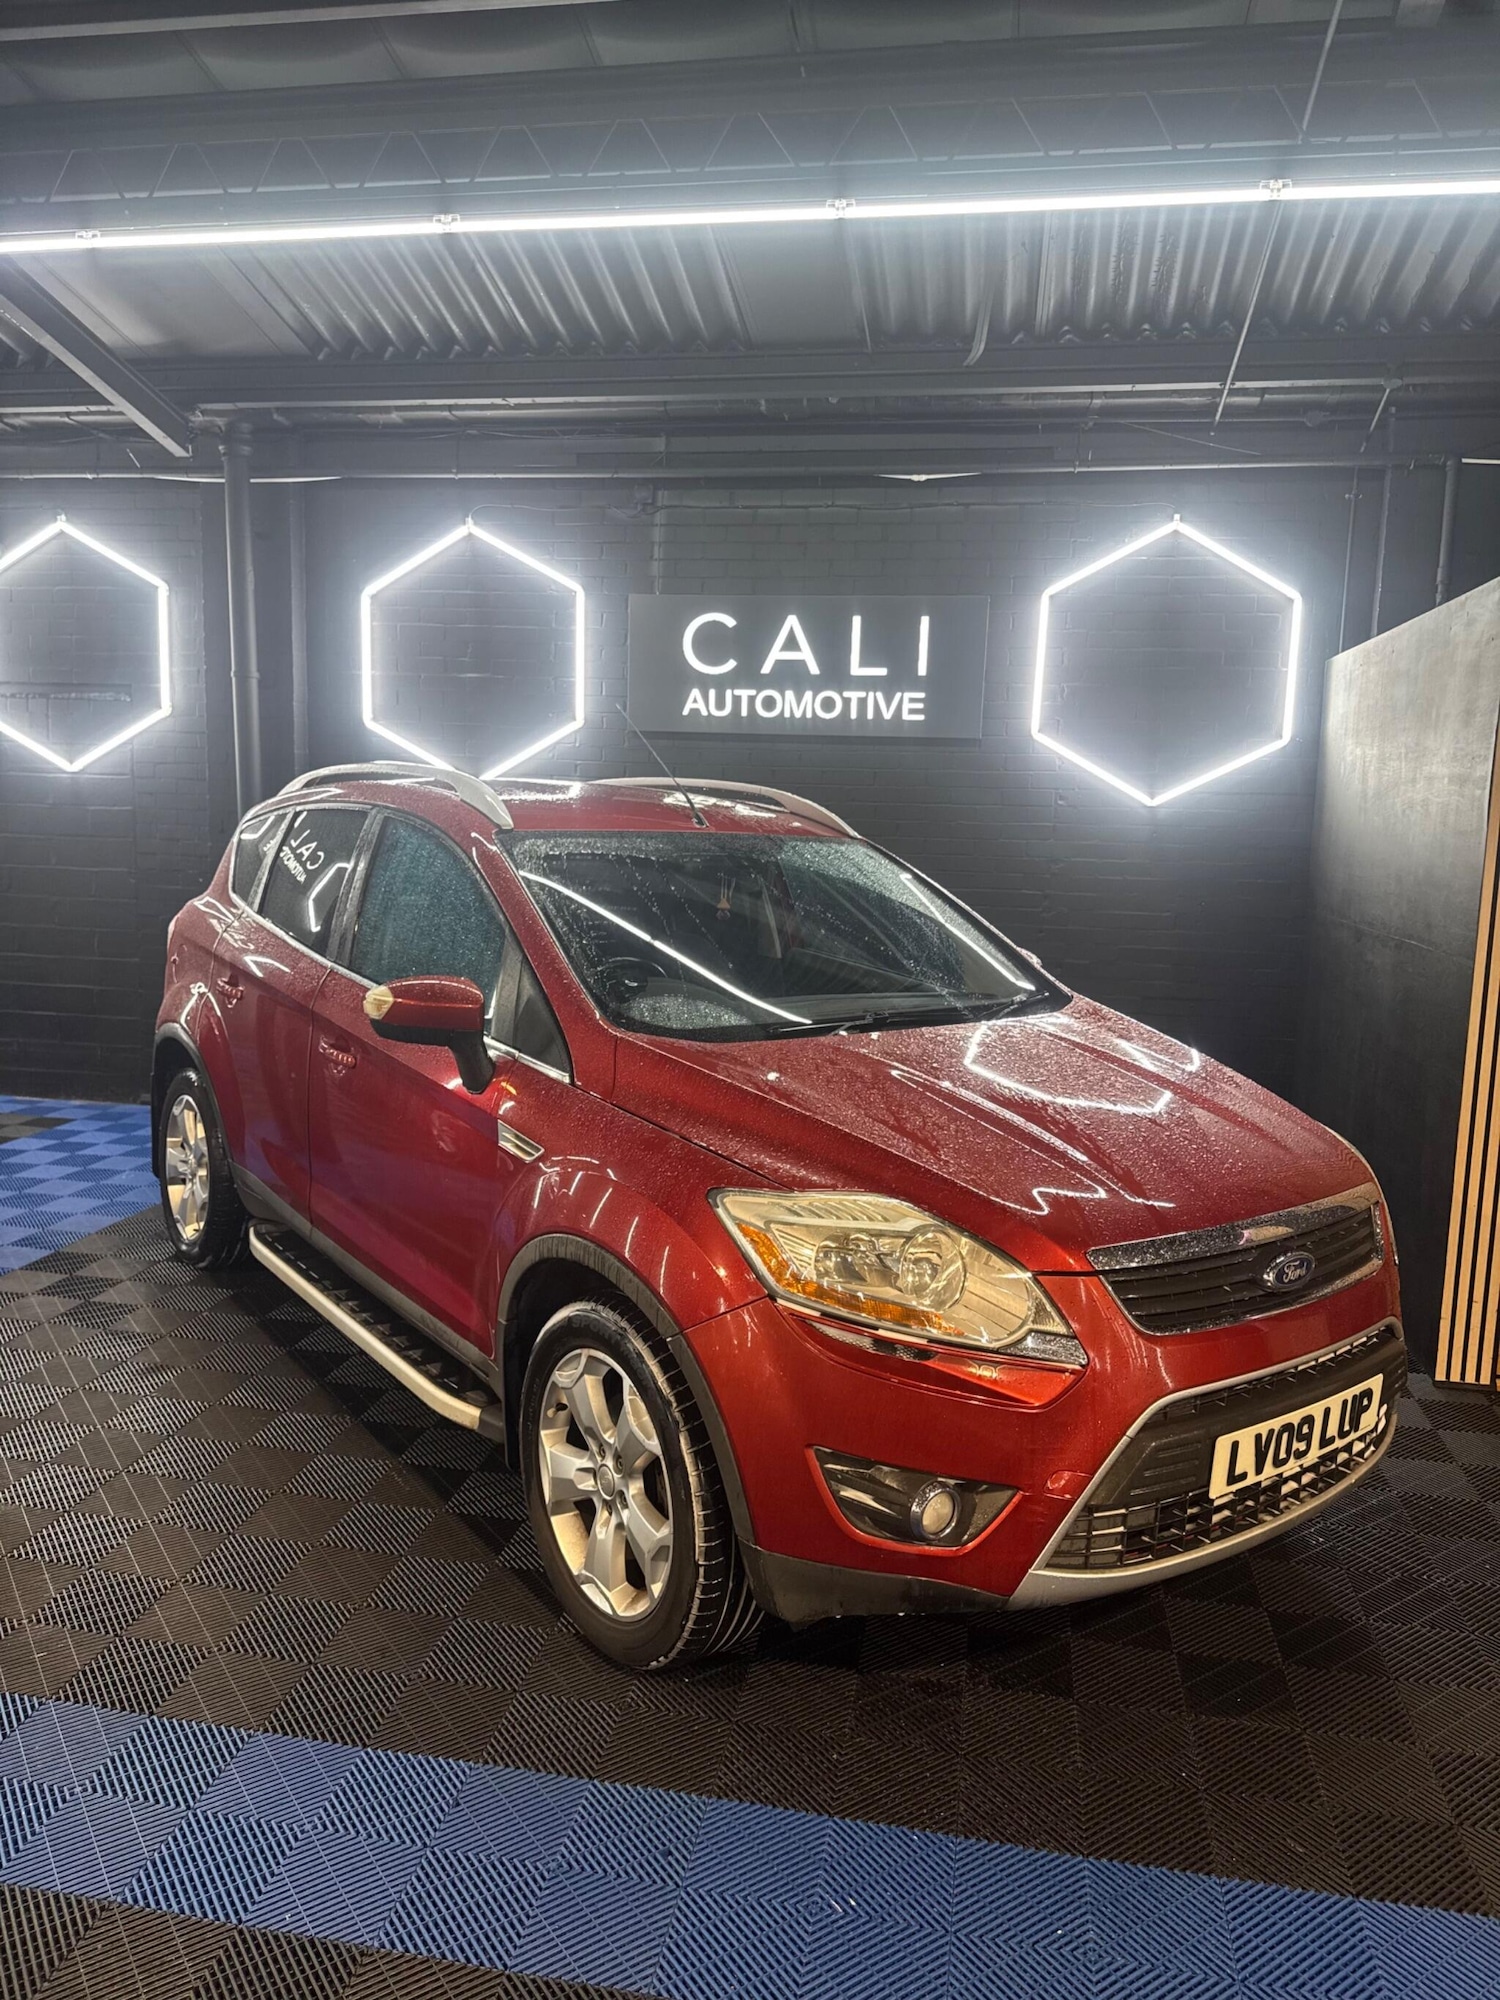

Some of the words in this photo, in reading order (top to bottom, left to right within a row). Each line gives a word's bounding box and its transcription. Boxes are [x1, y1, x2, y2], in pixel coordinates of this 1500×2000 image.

[682, 612, 930, 677] CALI
[682, 688, 926, 721] AUTOMOTIVE
[1283, 1260, 1307, 1283] Ford
[1226, 1414, 1315, 1487] LV09
[1319, 1387, 1374, 1450] LUP
